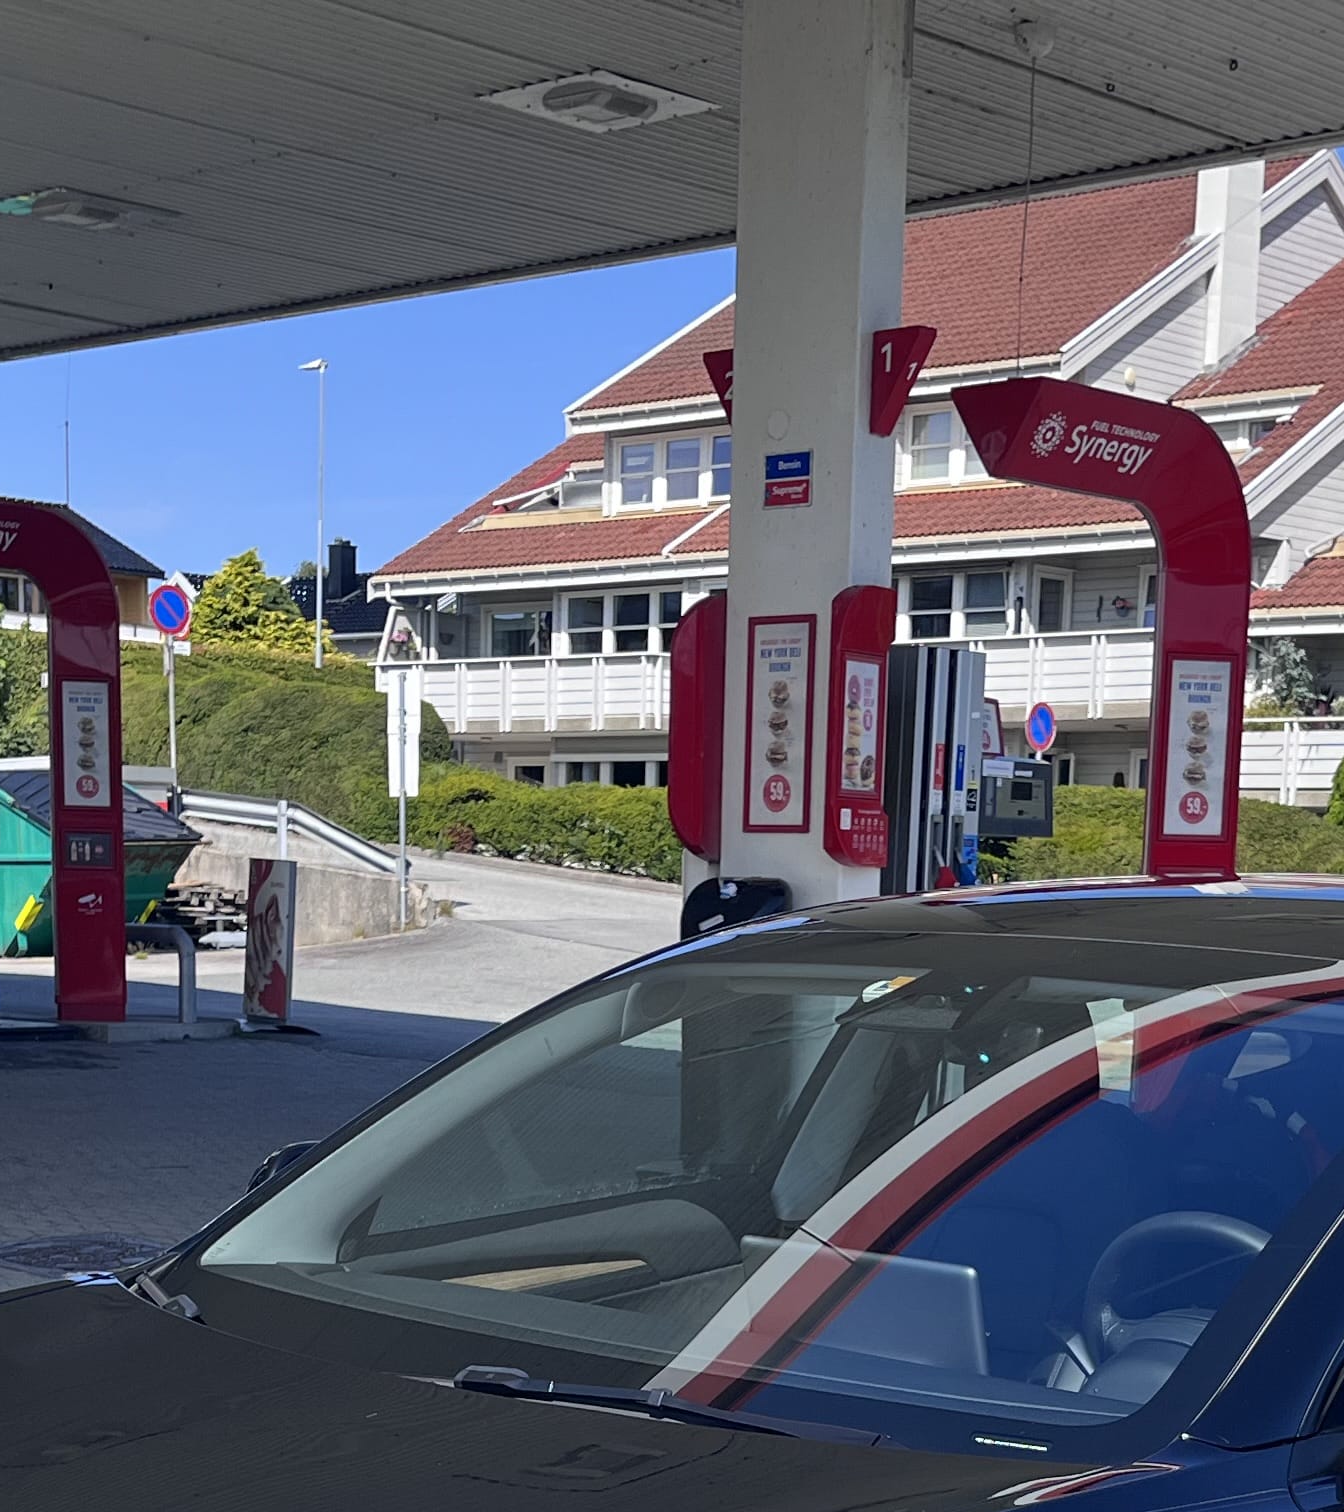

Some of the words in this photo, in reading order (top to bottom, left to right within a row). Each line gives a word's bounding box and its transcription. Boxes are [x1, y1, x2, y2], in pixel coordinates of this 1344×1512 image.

[880, 341, 894, 373] 1
[906, 361, 918, 381] 1
[1090, 420, 1110, 433] FUEL
[1111, 423, 1161, 443] TECHNOLOGY
[1064, 424, 1153, 475] Synergy
